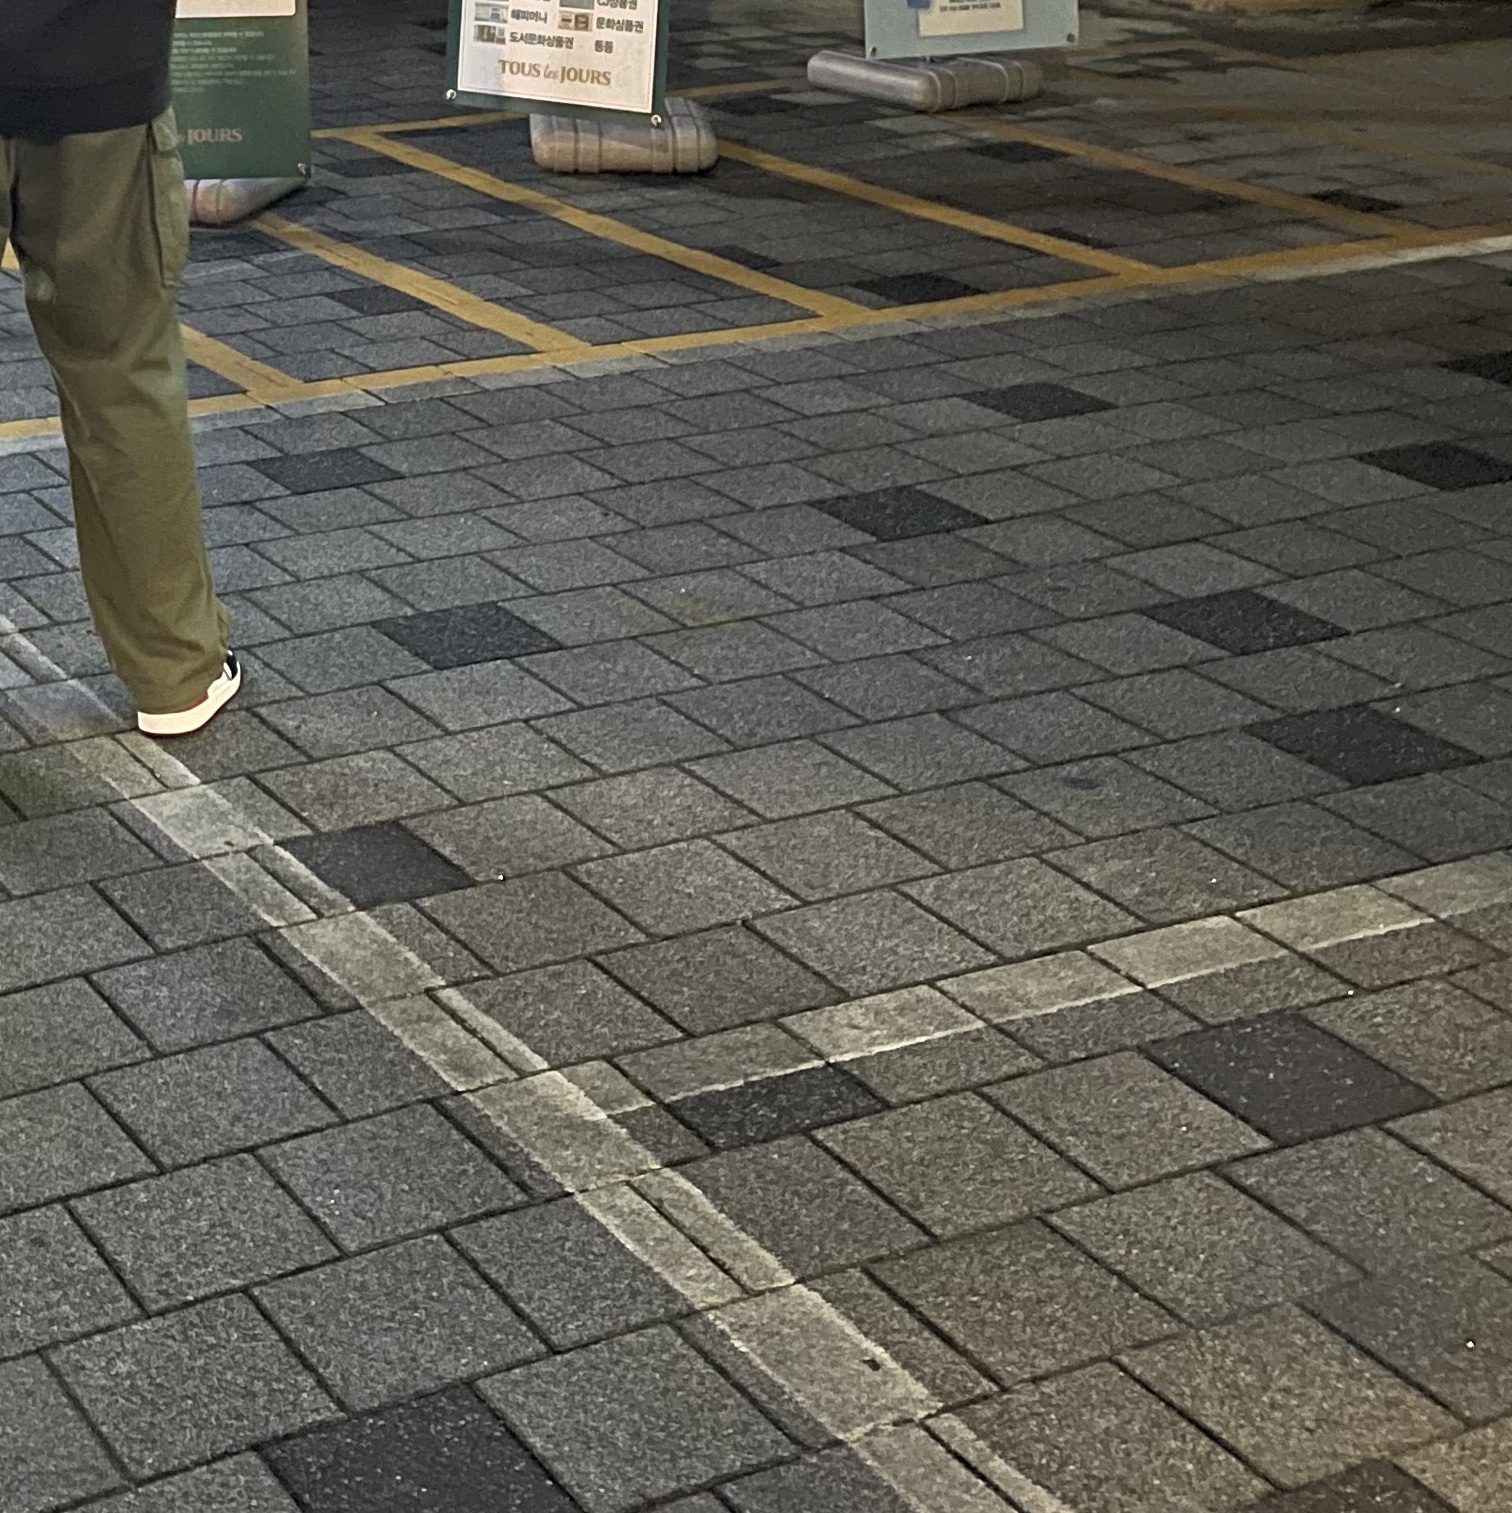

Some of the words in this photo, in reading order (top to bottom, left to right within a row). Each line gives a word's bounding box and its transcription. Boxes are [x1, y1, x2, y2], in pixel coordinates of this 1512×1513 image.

[498, 59, 541, 77] TOUS
[560, 66, 612, 86] JOURS
[188, 128, 243, 143] JOURS
